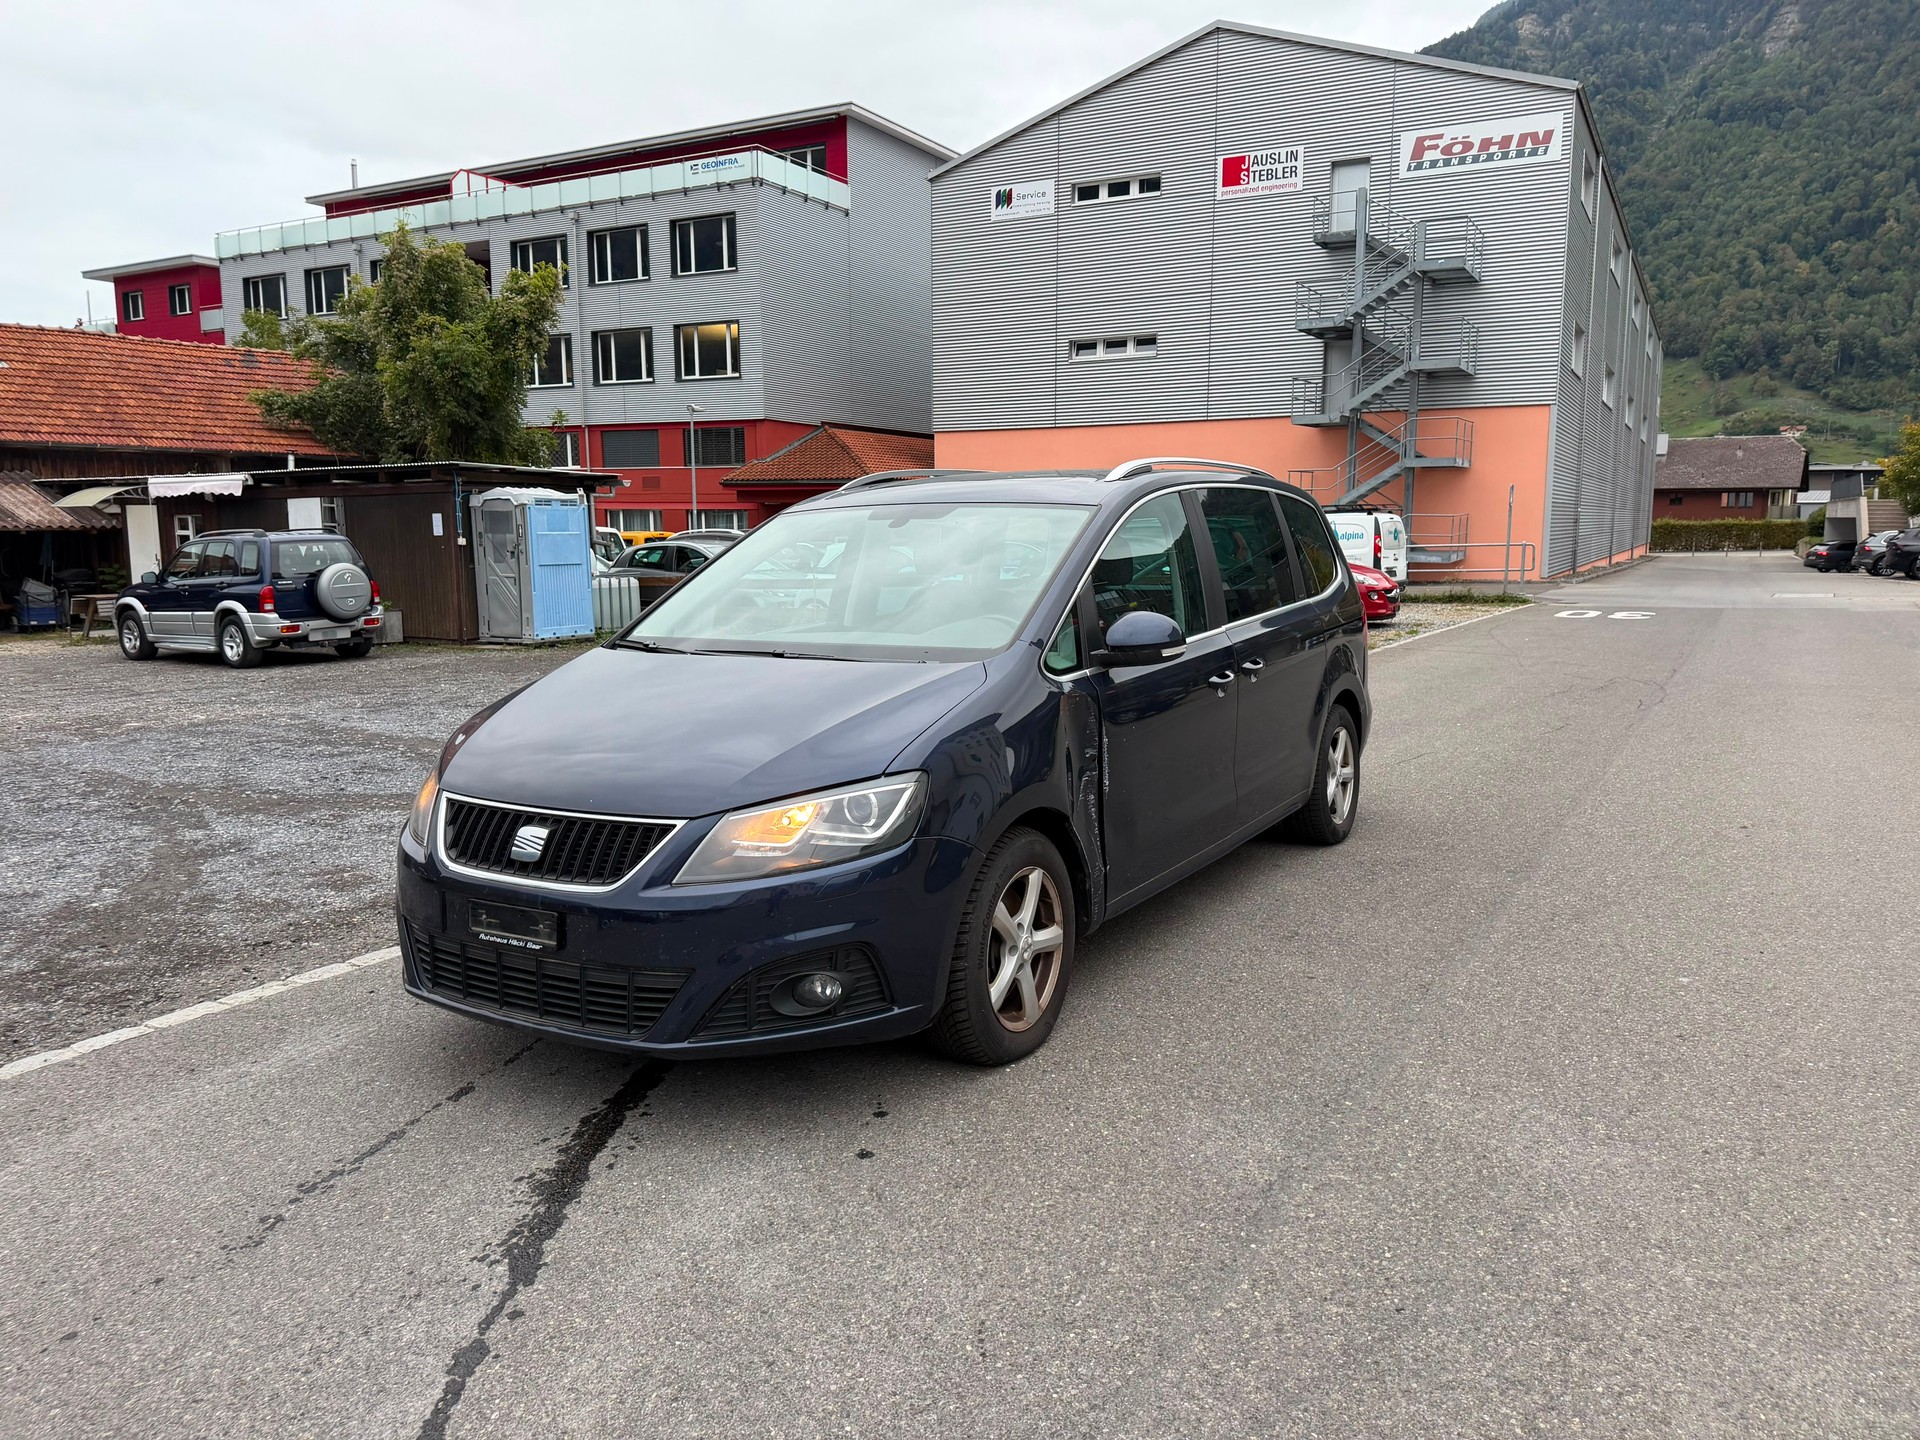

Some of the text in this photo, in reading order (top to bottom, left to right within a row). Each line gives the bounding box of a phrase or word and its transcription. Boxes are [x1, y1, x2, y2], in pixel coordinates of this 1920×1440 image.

[1410, 129, 1555, 161] FÖHN
[701, 157, 739, 170] GEOINFRA
[1241, 149, 1299, 169] JAUSLIN
[1409, 147, 1546, 171] TRANSPORTE
[1240, 165, 1298, 184] STEBLER
[1221, 181, 1298, 197] personalized engineering
[1340, 531, 1364, 541] alpina
[479, 933, 508, 944] Autohaus
[526, 942, 543, 950] Baar
